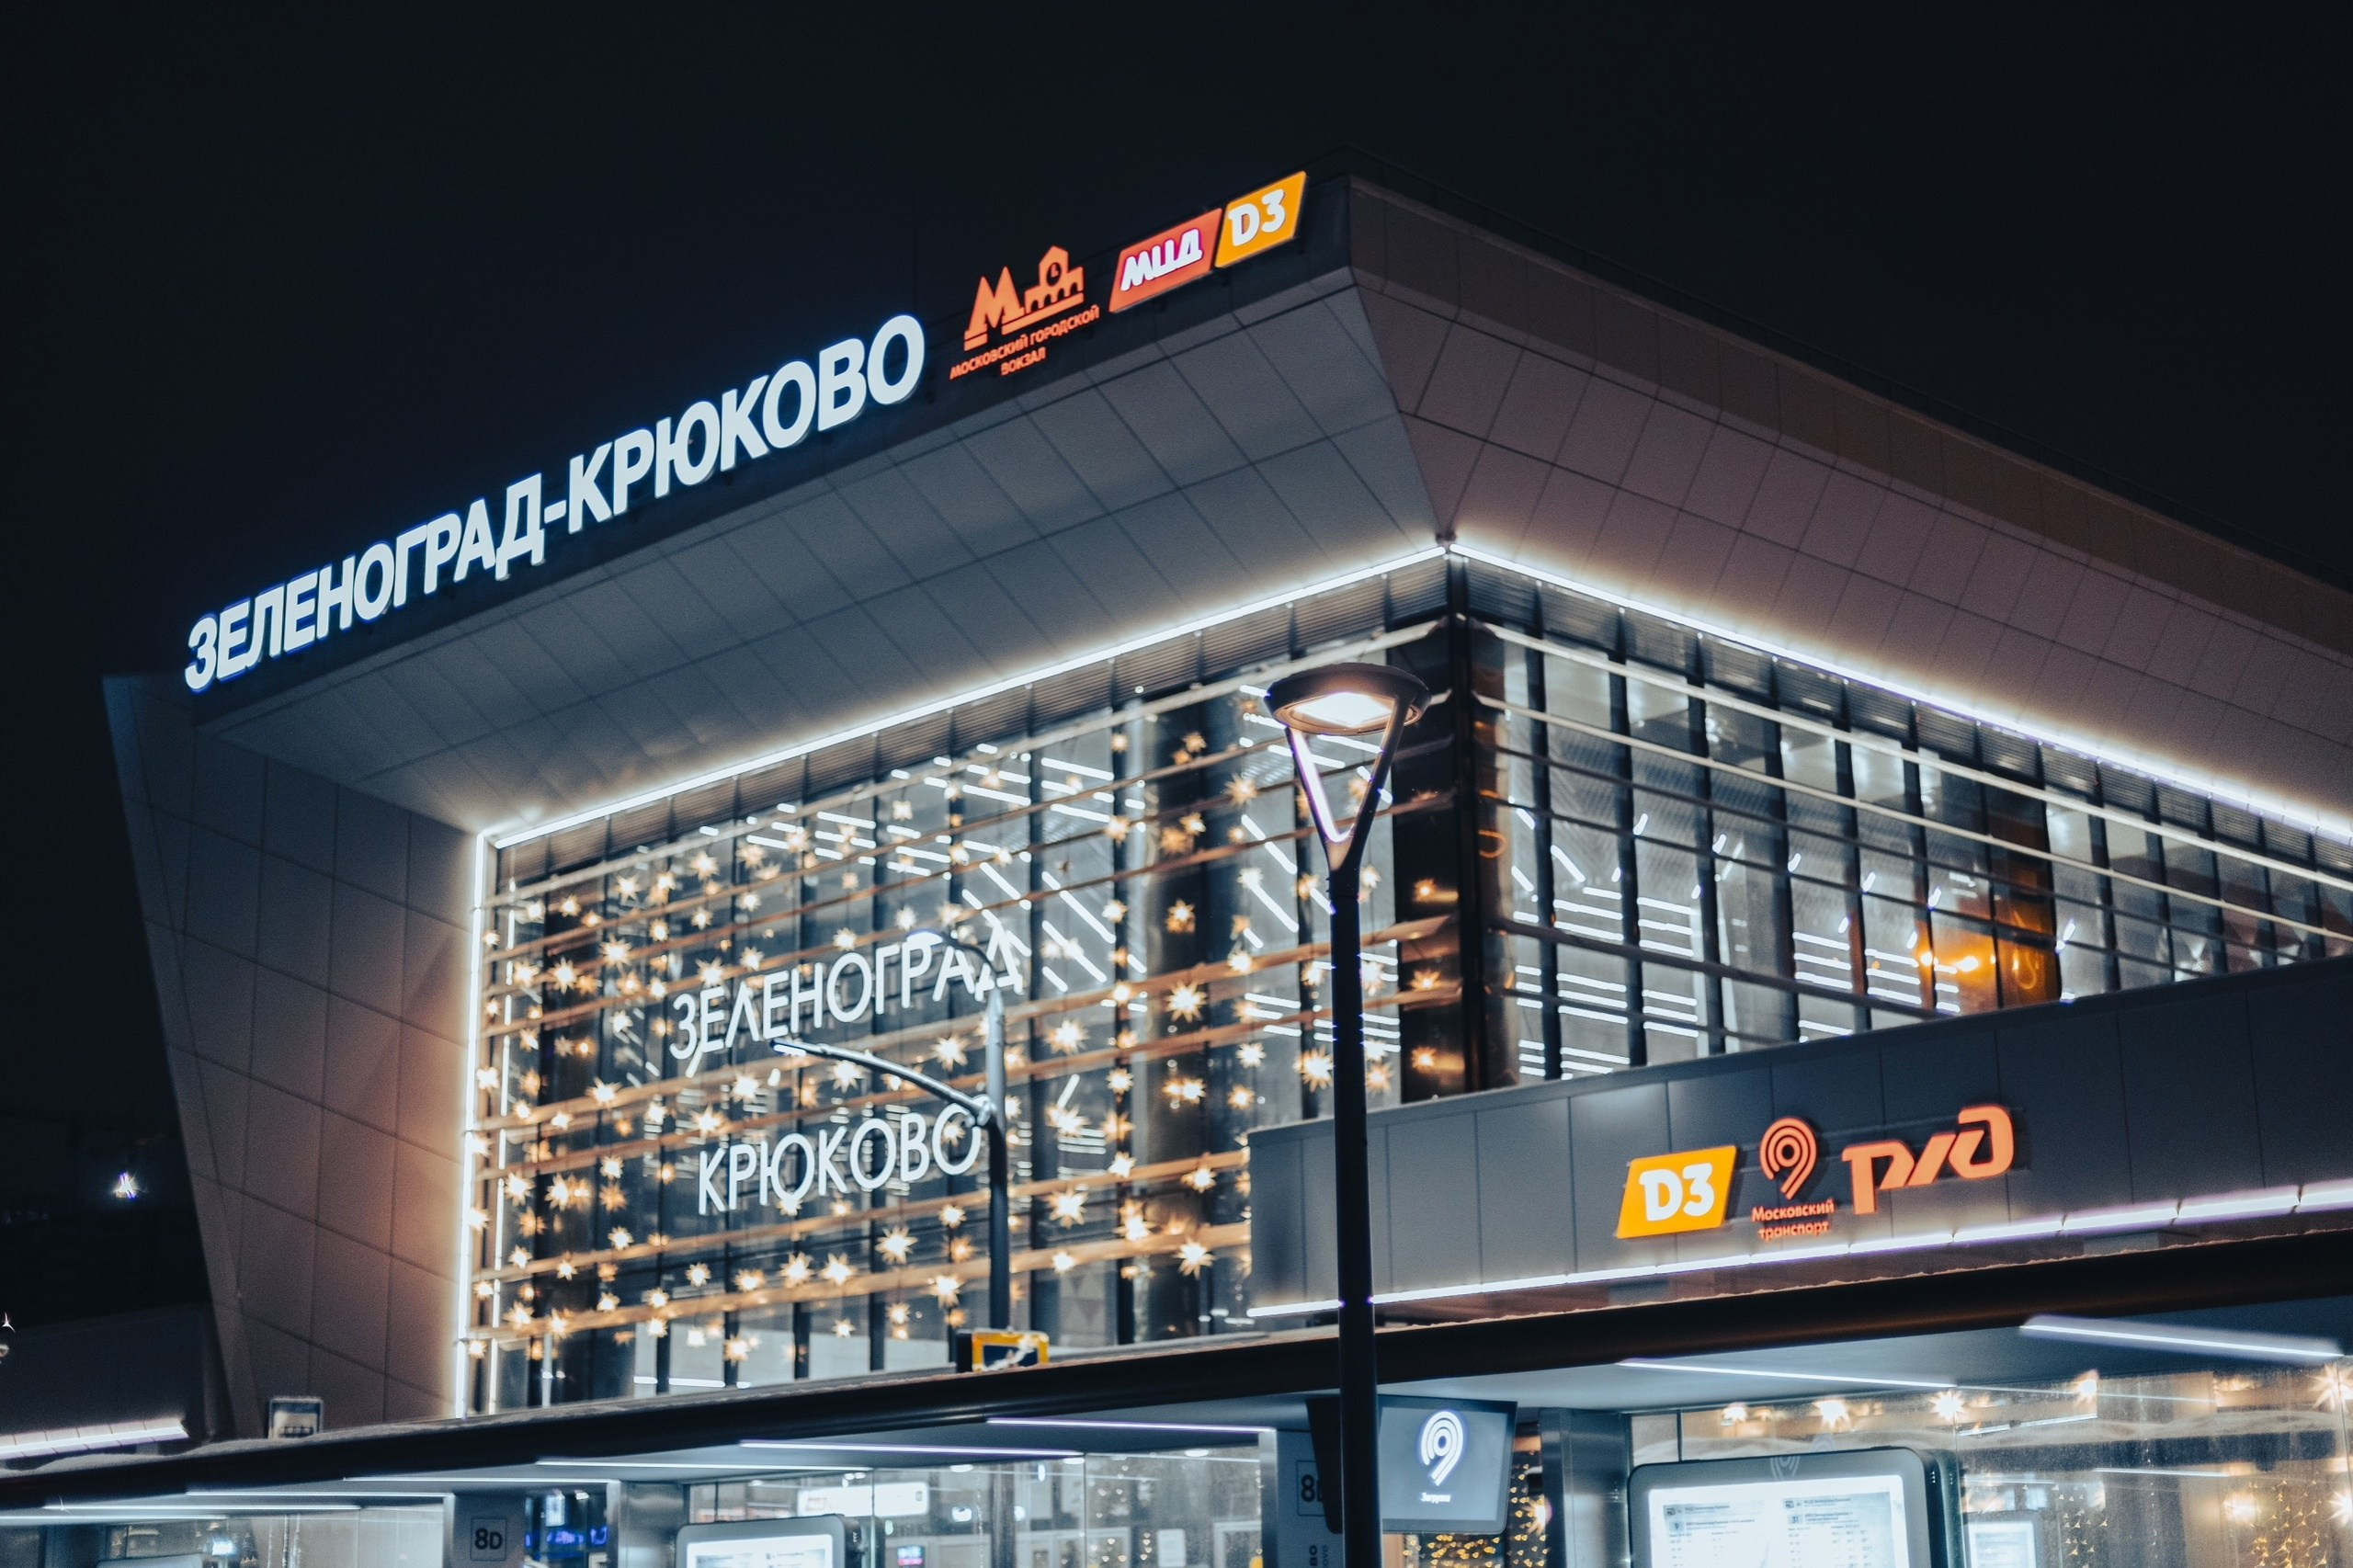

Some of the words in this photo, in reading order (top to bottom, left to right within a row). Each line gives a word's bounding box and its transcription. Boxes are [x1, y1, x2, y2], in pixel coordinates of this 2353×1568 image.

[1227, 188, 1286, 246] D3
[1120, 229, 1203, 291] МЦД
[949, 334, 1029, 380] МОСКОВСКИЙ
[1029, 304, 1100, 346] ГОРОДСКОЙ
[1001, 347, 1046, 376] ВОКЗАЛ
[184, 314, 925, 691] ЗЕЛЕНОГРАД-КРЮКОВО
[669, 926, 1025, 1060] ЗЕЛЕНОГРАД
[699, 1102, 982, 1215] КРЮКОВО
[1639, 1163, 1715, 1222] D3
[1751, 1198, 1835, 1222] Московский
[1758, 1221, 1829, 1242] транспорт
[474, 1528, 503, 1550] 8D
